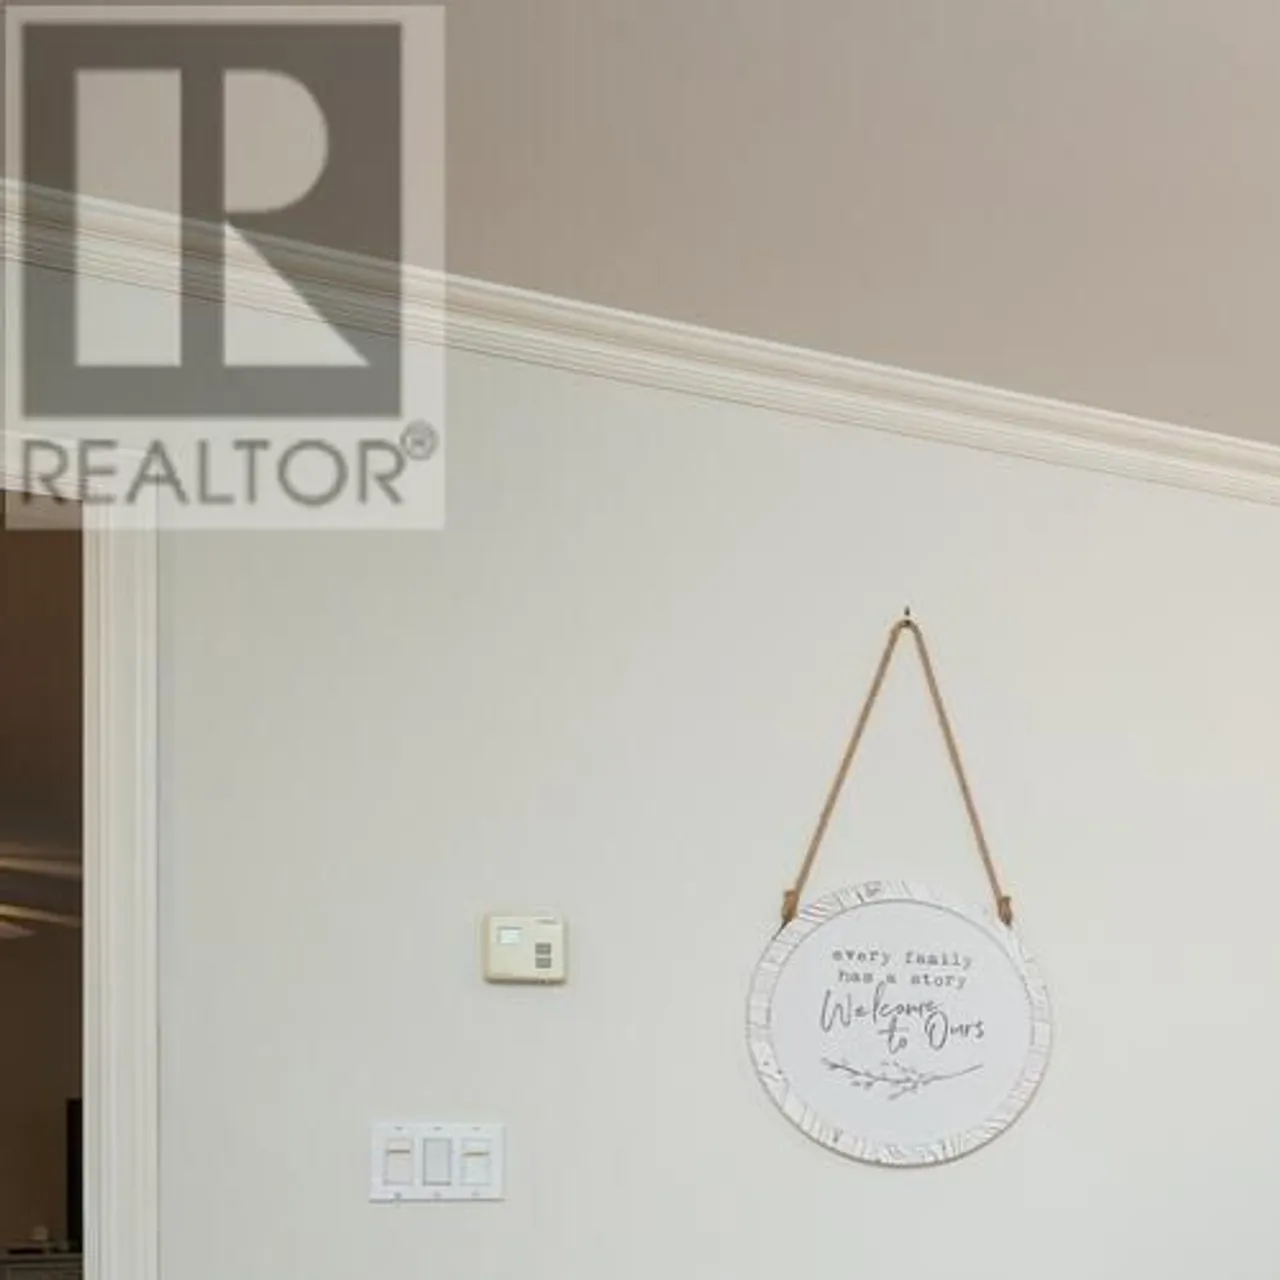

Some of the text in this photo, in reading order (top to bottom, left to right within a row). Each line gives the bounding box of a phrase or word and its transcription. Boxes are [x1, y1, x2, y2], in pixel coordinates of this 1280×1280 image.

[831, 949, 972, 970] every family
[838, 969, 967, 990] has a story
[821, 980, 940, 1033] Welcome
[877, 1010, 984, 1054] to Ours
